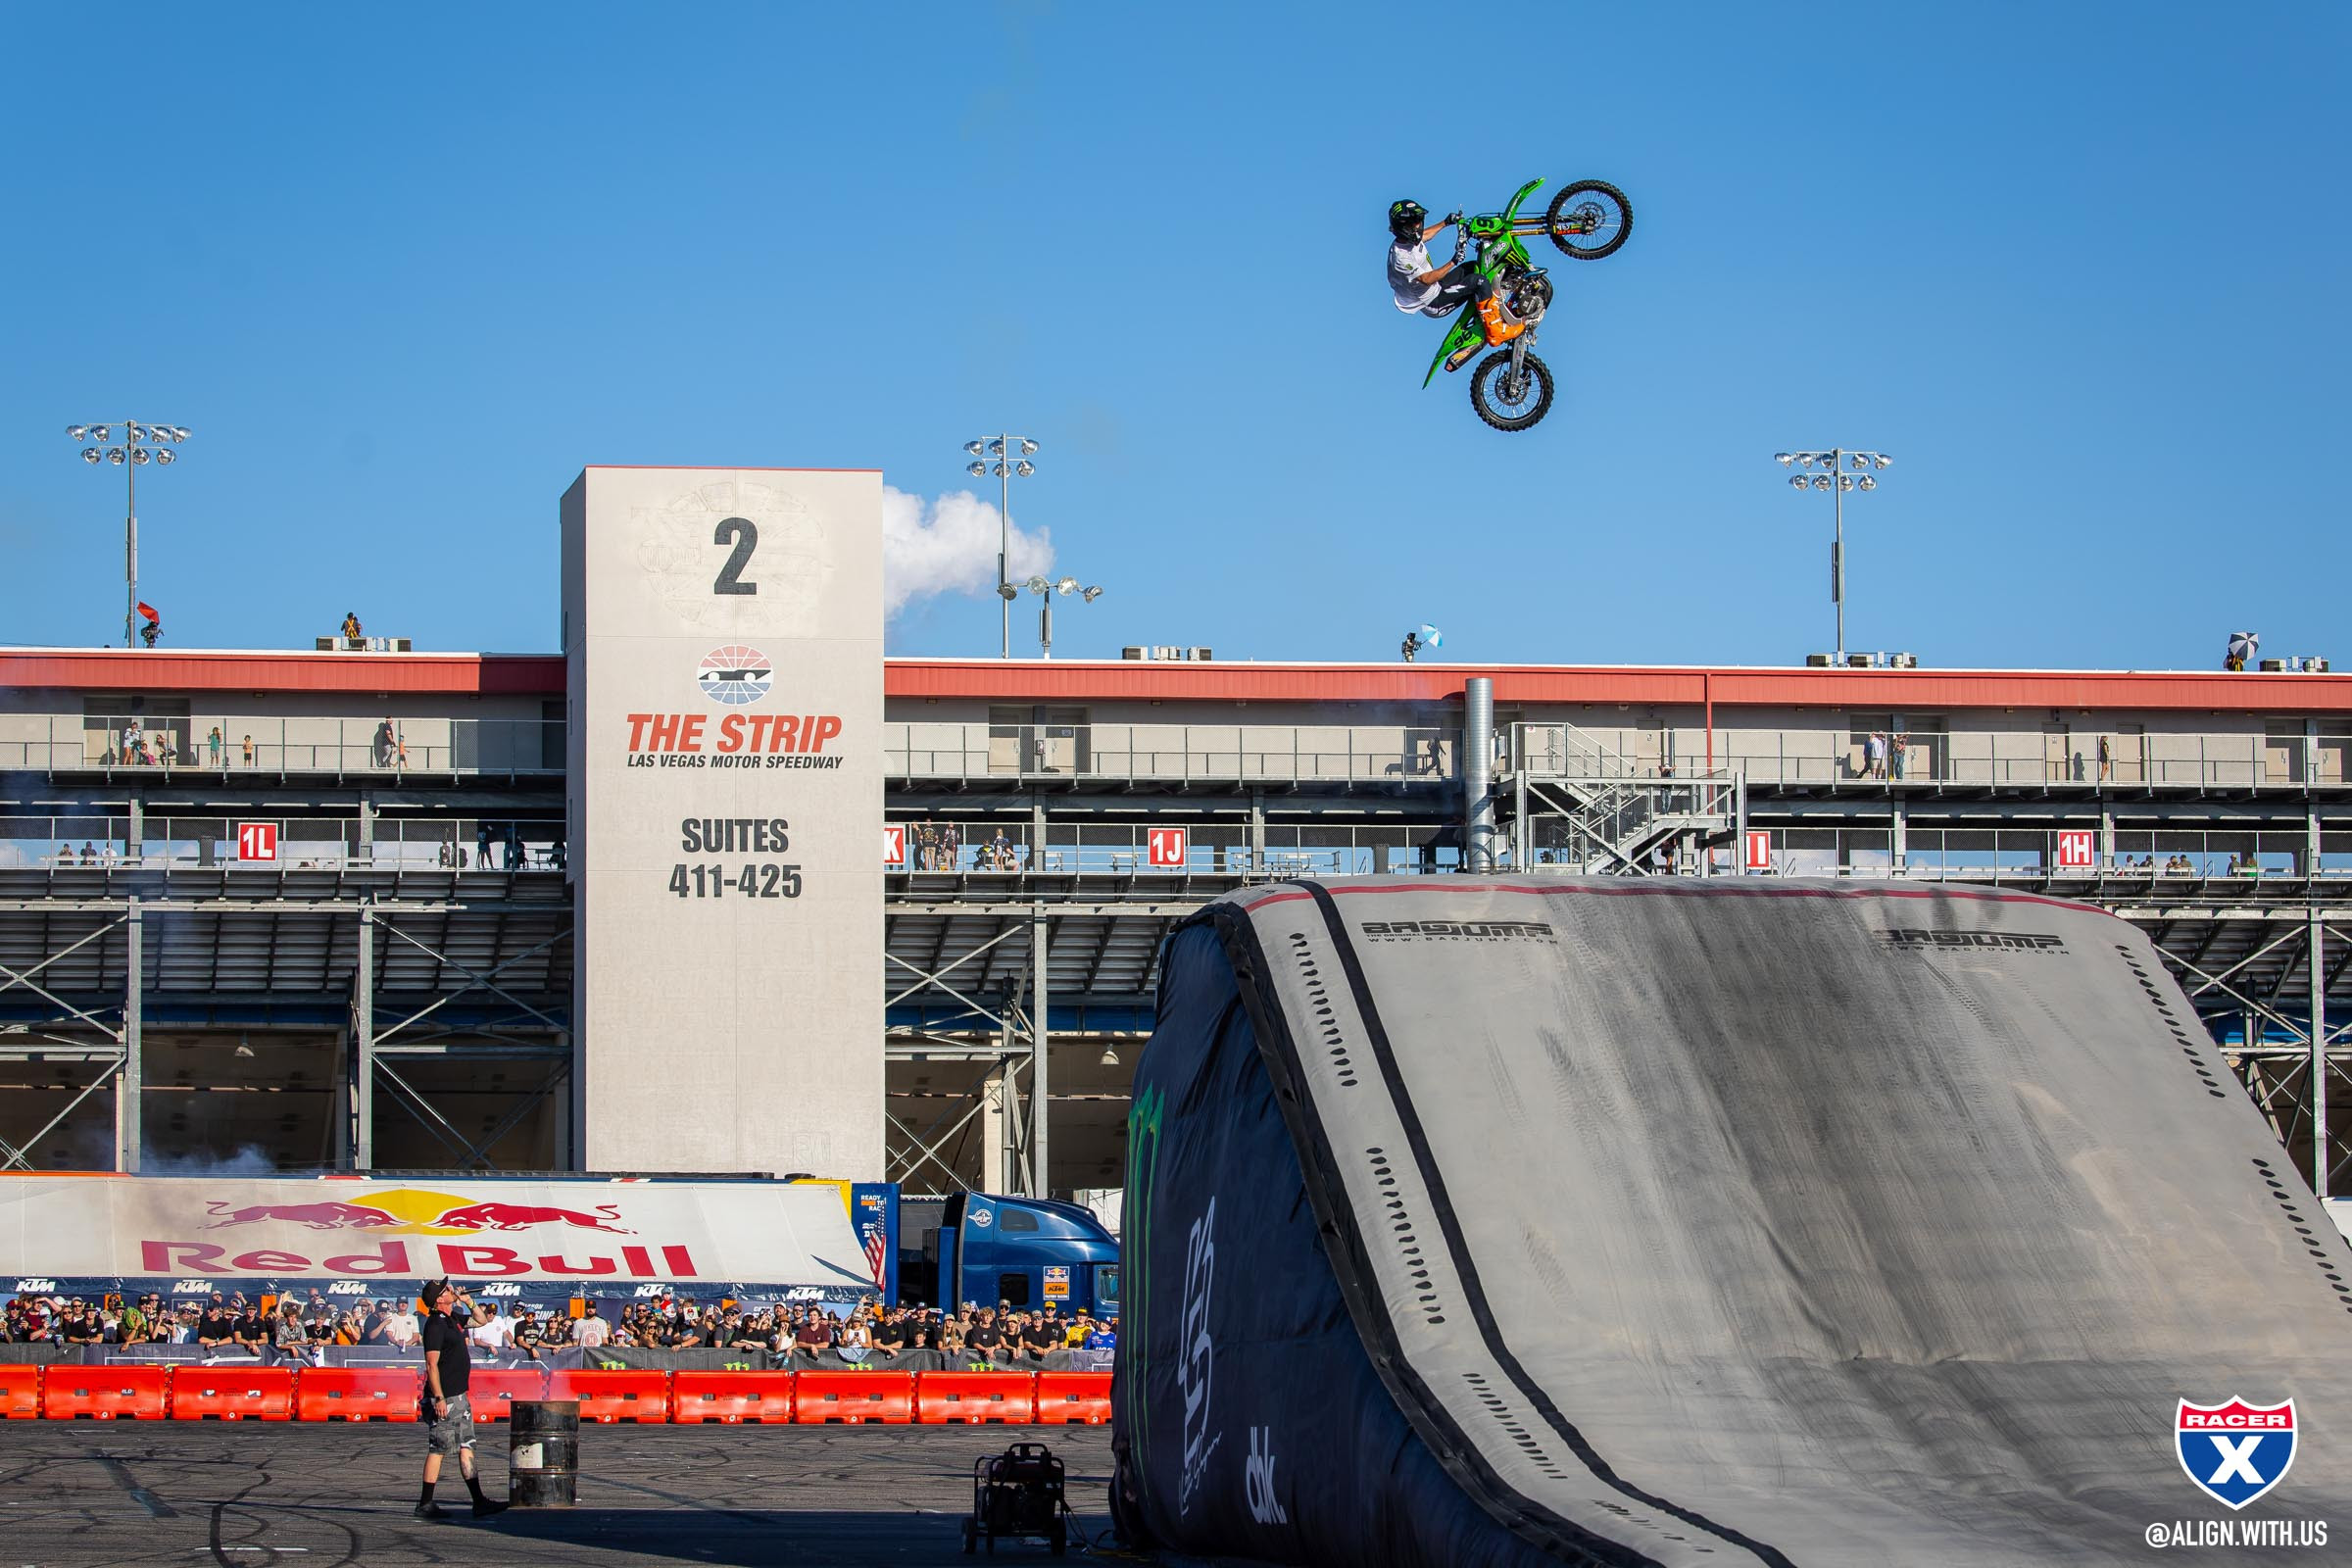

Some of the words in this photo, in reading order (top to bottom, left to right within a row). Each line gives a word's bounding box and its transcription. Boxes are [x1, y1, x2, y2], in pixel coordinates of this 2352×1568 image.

[713, 516, 759, 596] 2
[627, 713, 708, 752] THE
[716, 713, 843, 754] STRIP
[627, 755, 655, 767] LAS
[661, 755, 707, 768] VEGAS
[710, 755, 761, 769] MOTOR
[766, 756, 844, 769] SPEEDWAY
[243, 827, 272, 858] 1L
[681, 817, 790, 855] SUITES
[1152, 832, 1182, 862] 1J
[2061, 834, 2090, 863] 1H
[668, 862, 803, 900] 411-425
[141, 1240, 410, 1274] Red
[436, 1243, 698, 1277] Bull
[16, 1278, 55, 1293] KTM
[172, 1279, 213, 1294] KTM
[327, 1280, 368, 1295] KTM
[481, 1282, 521, 1297] KTM
[786, 1287, 825, 1300] KTM
